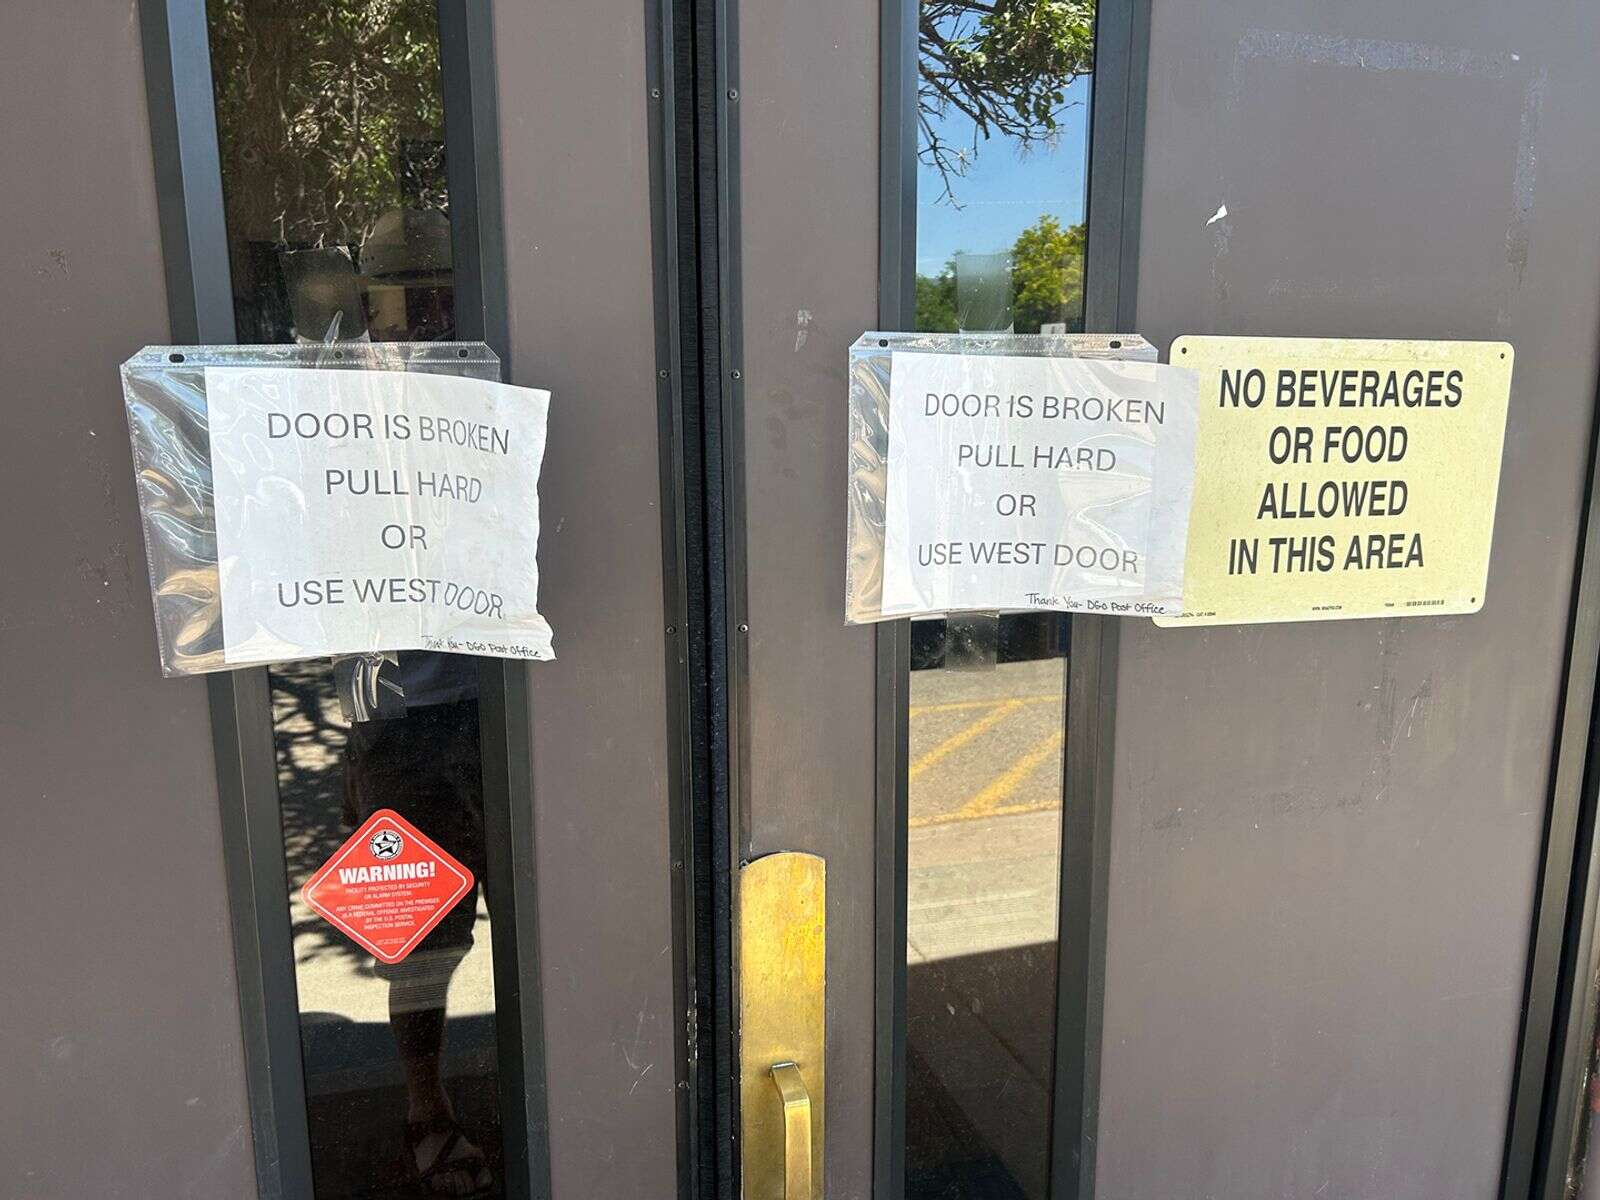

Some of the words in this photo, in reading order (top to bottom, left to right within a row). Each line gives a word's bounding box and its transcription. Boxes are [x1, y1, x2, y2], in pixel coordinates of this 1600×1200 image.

[1219, 369, 1266, 408] NO
[1275, 369, 1464, 408] BEVERAGES
[925, 393, 1000, 417] DOOR
[1008, 395, 1034, 418] IS
[1043, 396, 1165, 424] BROKEN
[268, 413, 373, 439] DOOR
[384, 414, 411, 439] IS
[419, 416, 509, 454] BROKEN
[1269, 425, 1314, 465] OR
[1323, 425, 1408, 463] FOOD
[958, 444, 1024, 468] PULL
[1033, 446, 1116, 471] HARD
[325, 469, 409, 495] PULL
[418, 471, 482, 503] HARD
[1257, 480, 1408, 520] ALLOWED
[996, 494, 1036, 517] OR
[381, 524, 427, 550] OR
[918, 543, 962, 567] USE
[969, 542, 1046, 565] WEST
[1054, 544, 1138, 573] DOOR
[1228, 538, 1259, 575] IN
[1268, 535, 1335, 573] THIS
[1343, 533, 1424, 570] AREA
[278, 579, 344, 607] USE
[352, 578, 441, 603] WEST
[443, 582, 504, 619] DOOR
[1025, 593, 1059, 606] Thank
[1111, 602, 1132, 612] Post
[1134, 603, 1168, 614] Office
[510, 646, 541, 658] Office
[339, 861, 436, 885] WARNING!
